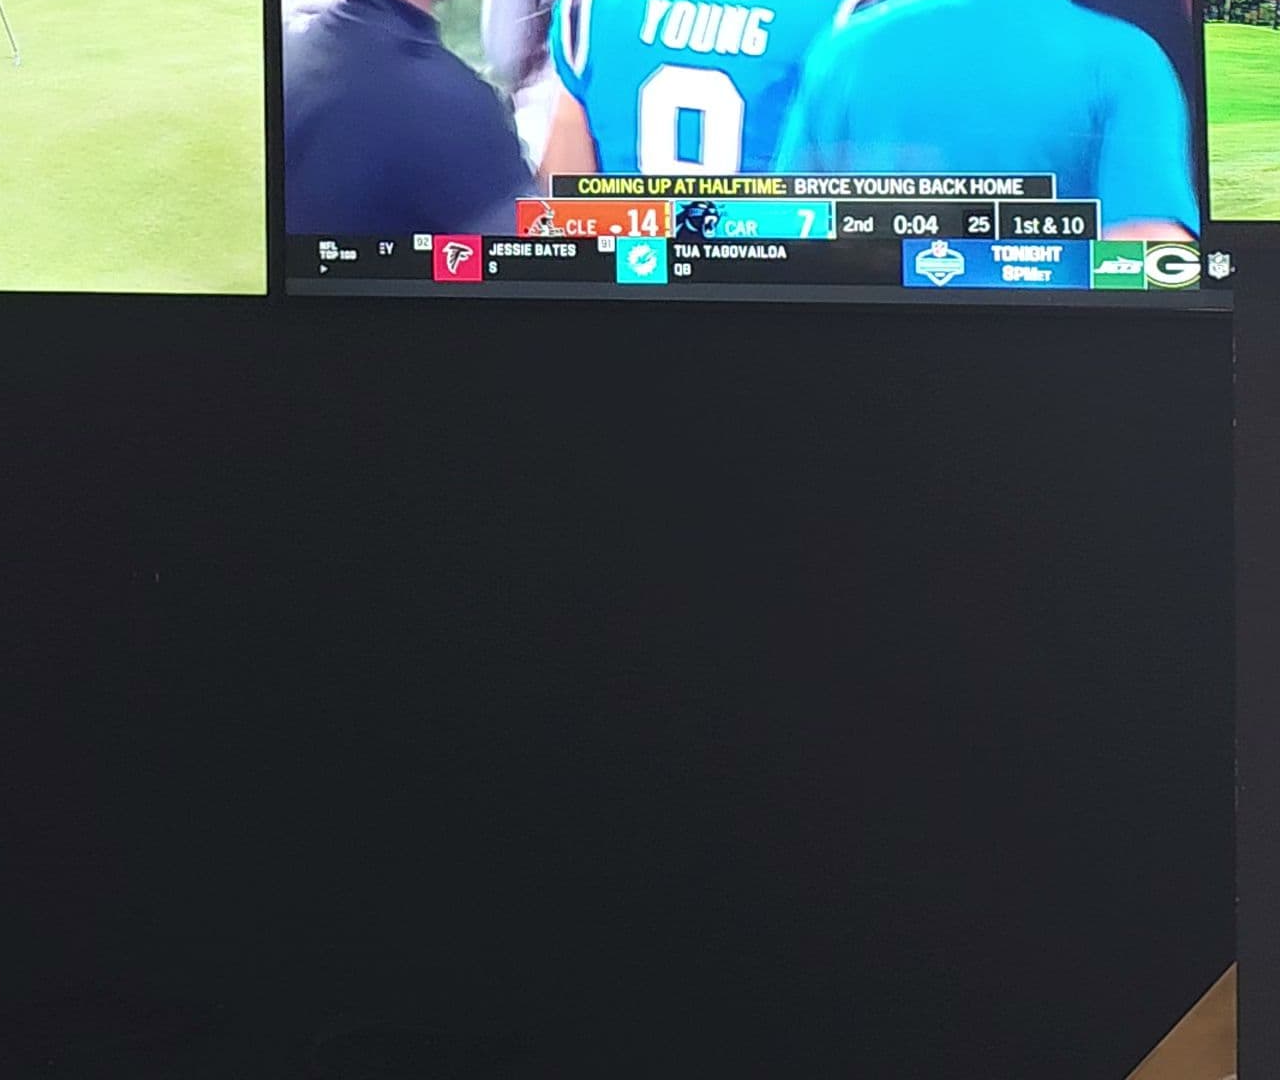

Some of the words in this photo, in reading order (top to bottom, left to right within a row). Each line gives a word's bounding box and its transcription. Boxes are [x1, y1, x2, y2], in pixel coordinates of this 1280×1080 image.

[578, 178, 644, 195] COMING
[647, 178, 672, 195] UP
[673, 178, 696, 195] AT
[699, 178, 788, 195] HALFTIME:
[794, 178, 852, 195] BRYCE
[852, 178, 917, 195] YOUNG
[919, 178, 968, 195] BACK
[970, 178, 1025, 195] HOME
[565, 219, 598, 236] CLE
[627, 208, 659, 237] 14
[724, 220, 758, 236] CAR
[796, 209, 816, 238] 7
[842, 216, 874, 233] 2nd
[893, 215, 939, 234] 0:04
[967, 216, 991, 233] 25
[1013, 216, 1040, 234] 1st
[1042, 217, 1058, 234] &
[1062, 217, 1085, 235] 10
[488, 243, 532, 257] JESSIE
[535, 243, 577, 257] BATES
[673, 244, 701, 259] TUA
[703, 244, 787, 259] TAGOVAILOA
[991, 245, 1063, 262] TONIGHT
[488, 261, 498, 274] S
[673, 263, 692, 277] QB
